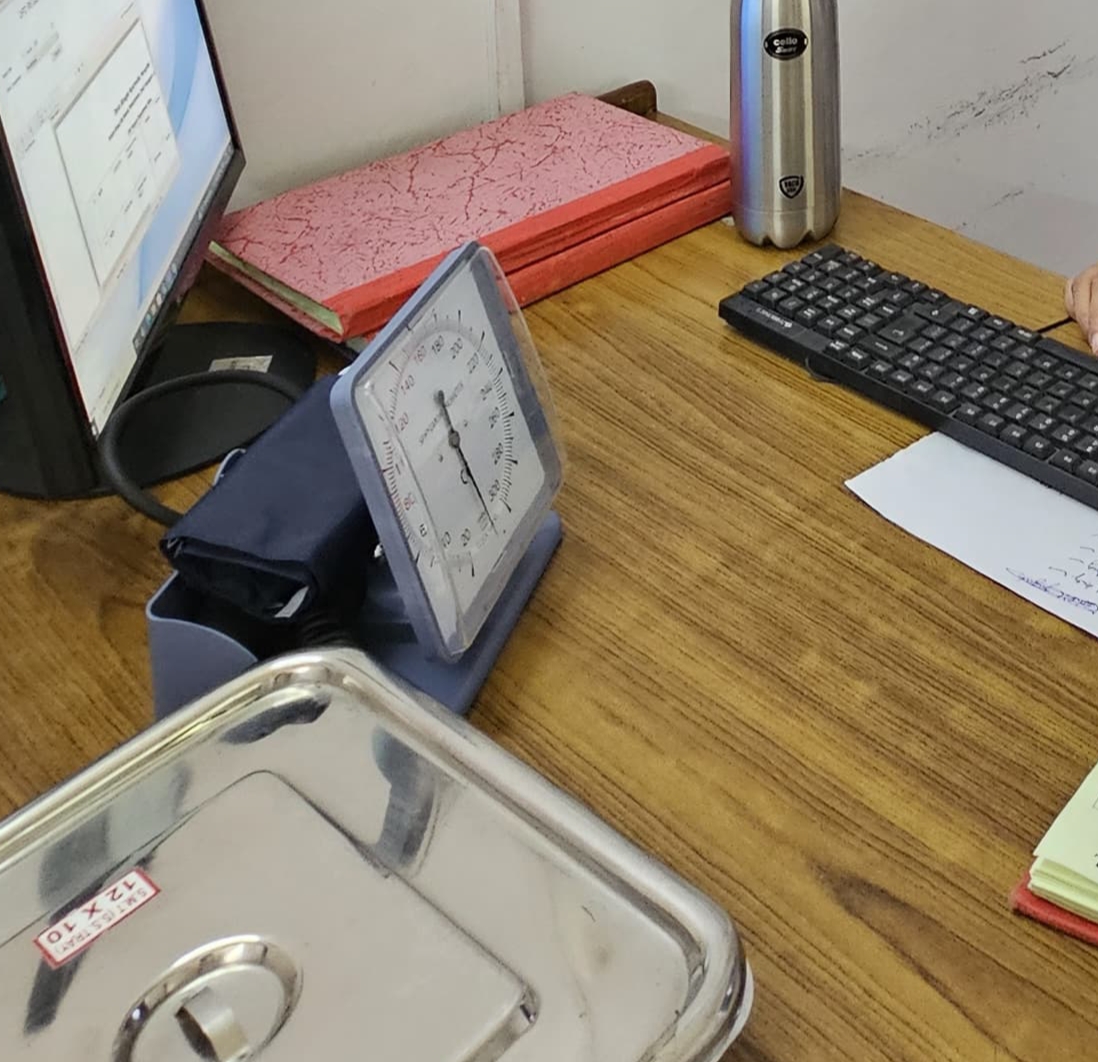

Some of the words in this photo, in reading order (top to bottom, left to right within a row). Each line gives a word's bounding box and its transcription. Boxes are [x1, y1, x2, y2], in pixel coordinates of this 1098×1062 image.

[772, 36, 798, 47] cello
[105, 879, 137, 903] 12
[46, 920, 78, 944] 10
